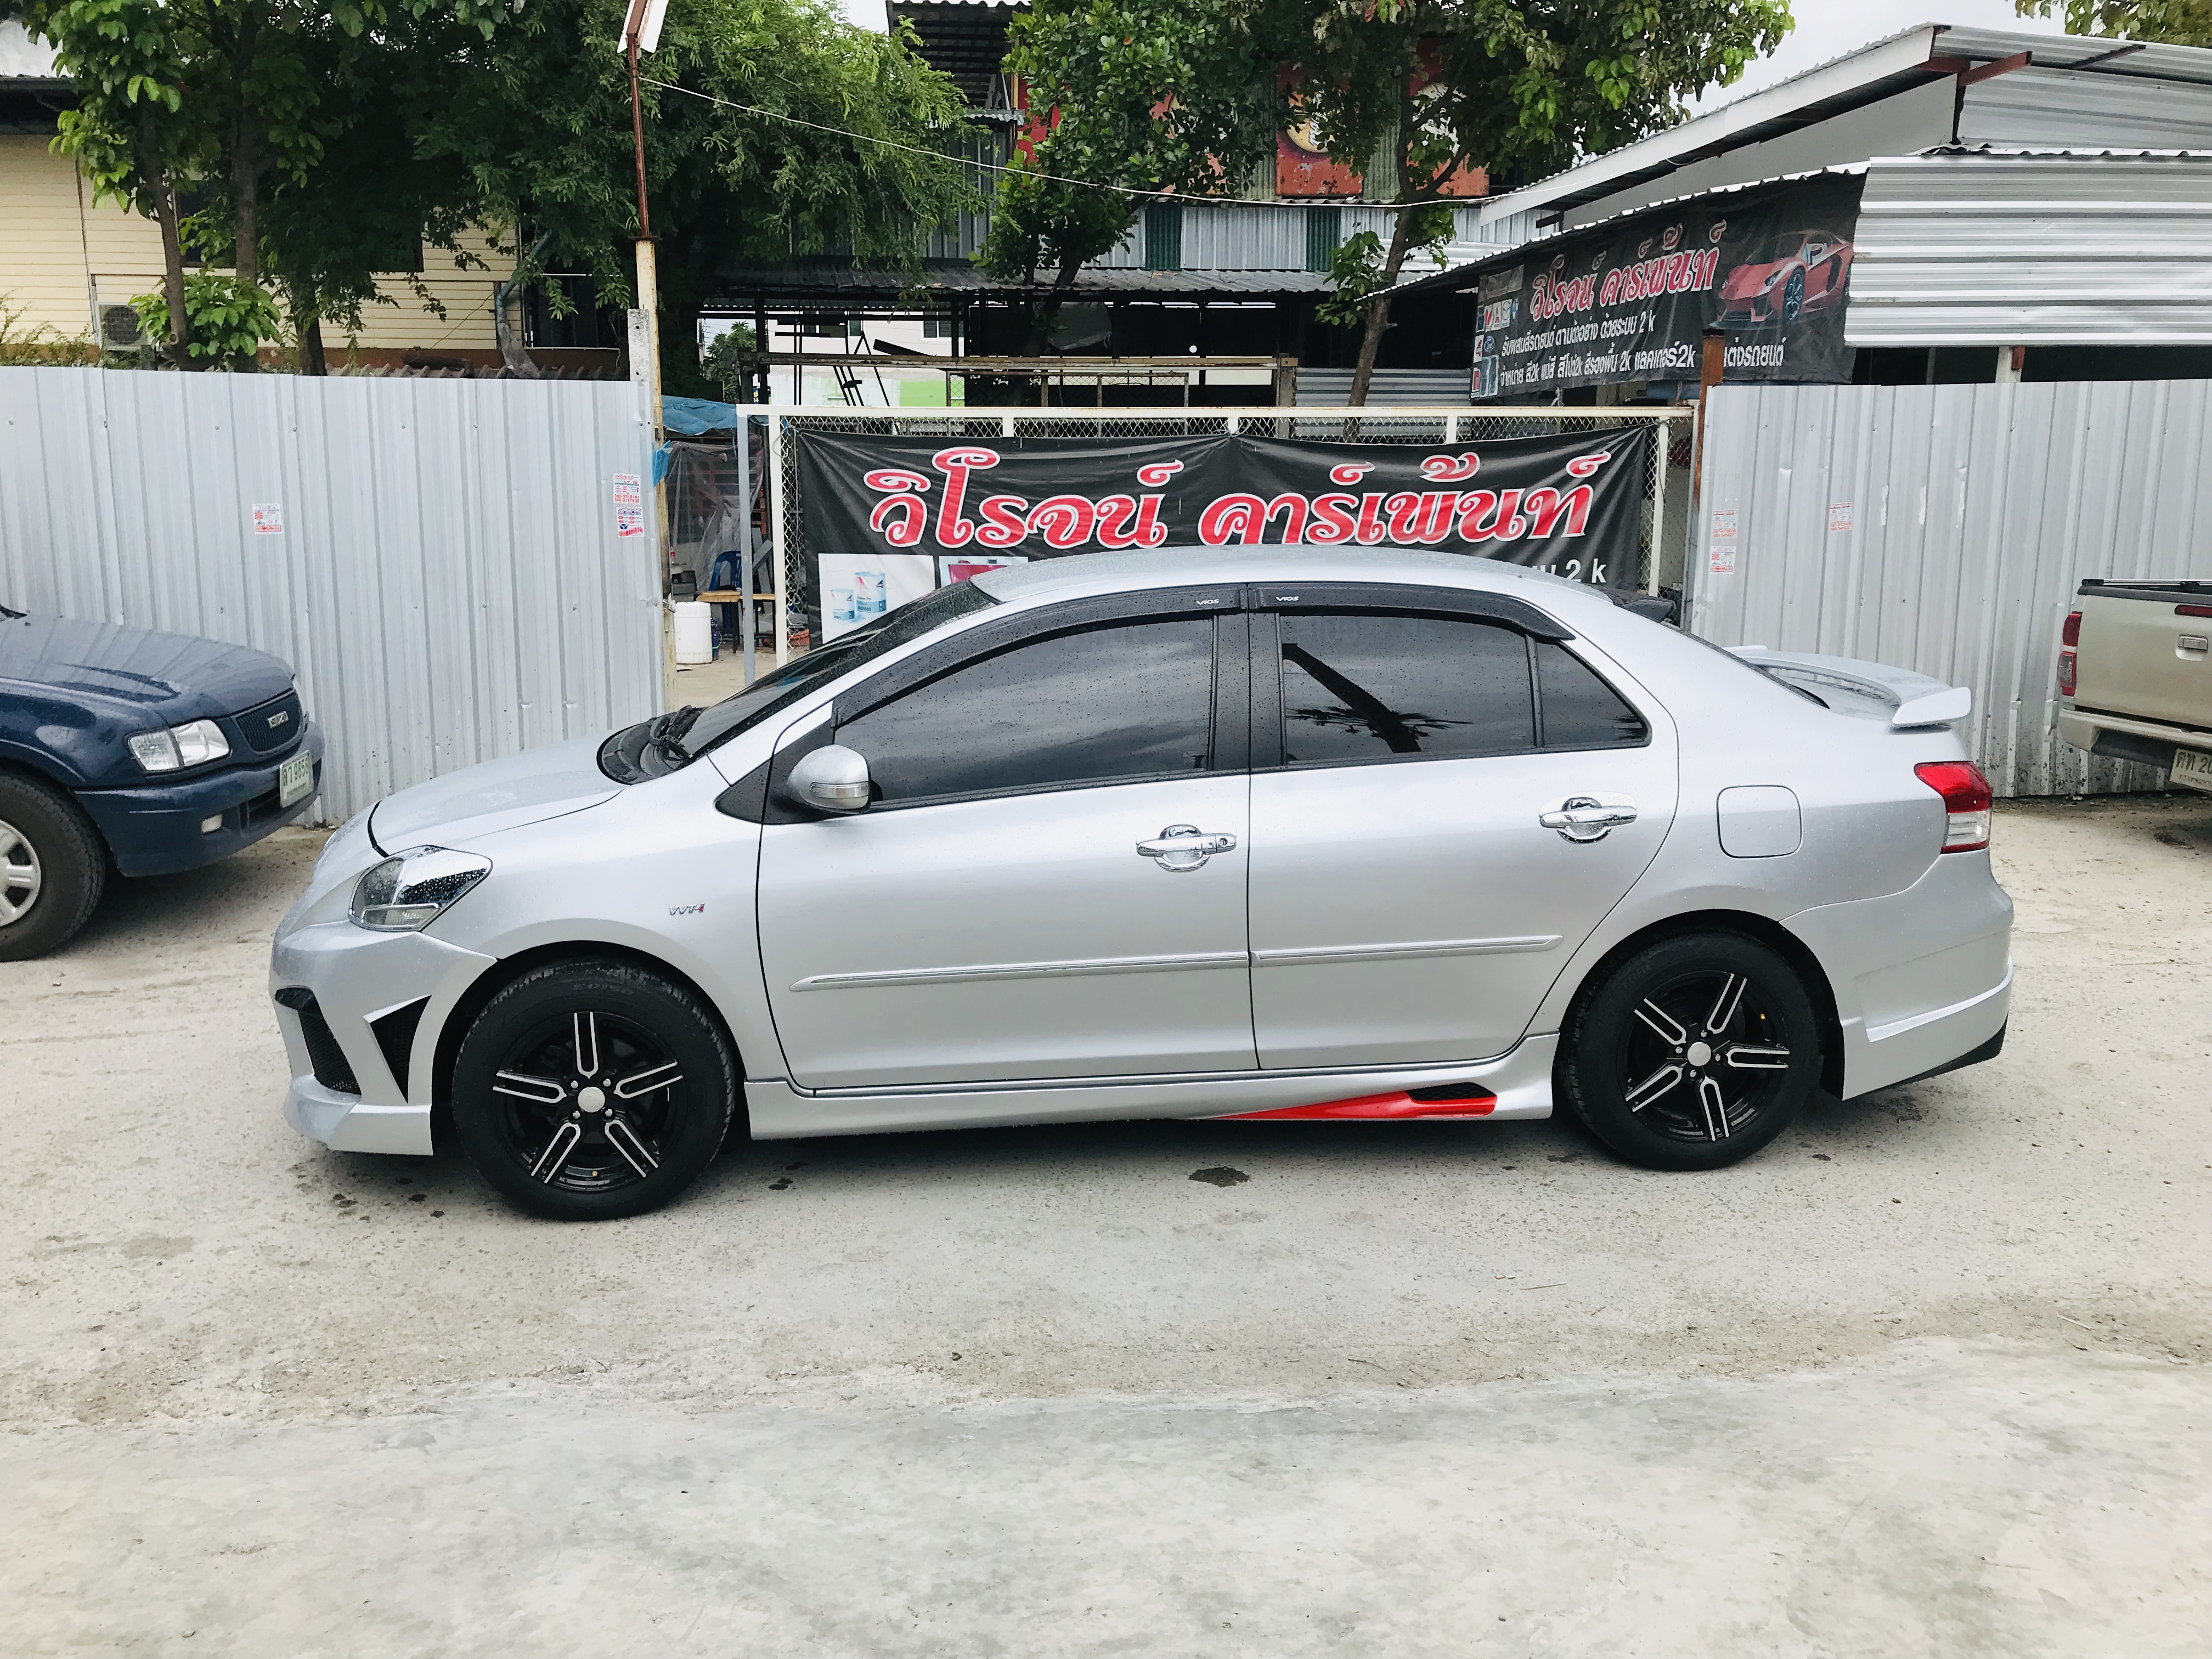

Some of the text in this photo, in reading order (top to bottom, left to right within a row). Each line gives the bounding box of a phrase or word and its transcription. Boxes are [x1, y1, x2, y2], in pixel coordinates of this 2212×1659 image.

[1530, 250, 1606, 322] วิโรจน์
[1600, 312, 1638, 339] ด้วยระบบ
[1639, 311, 1646, 334] 2
[1648, 309, 1656, 332] k
[1619, 349, 1632, 372] 2k
[863, 446, 1184, 549] วิโรจน์
[1566, 559, 1581, 583] 2
[1592, 558, 1607, 583] k
